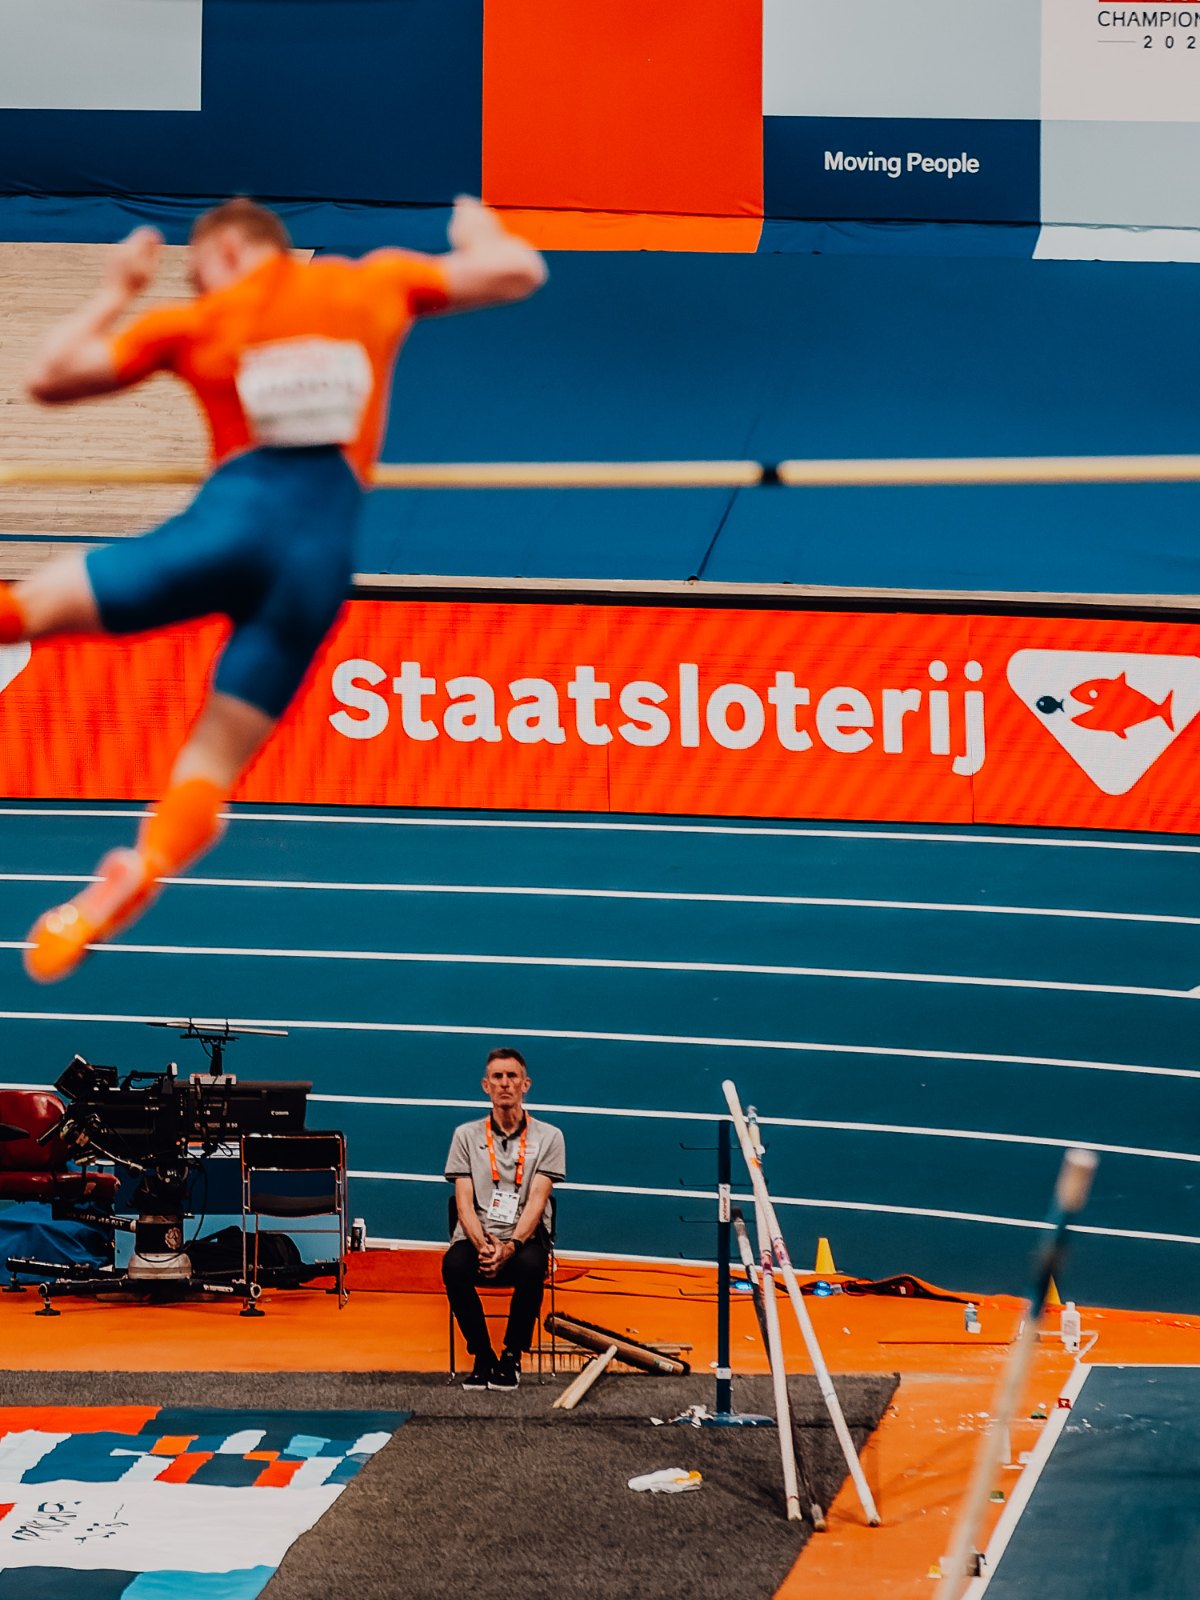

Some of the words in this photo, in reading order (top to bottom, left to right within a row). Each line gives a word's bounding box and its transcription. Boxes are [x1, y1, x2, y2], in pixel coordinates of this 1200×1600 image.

[824, 151, 902, 178] Moving
[907, 152, 980, 178] People
[328, 659, 986, 776] Staatsloterij
